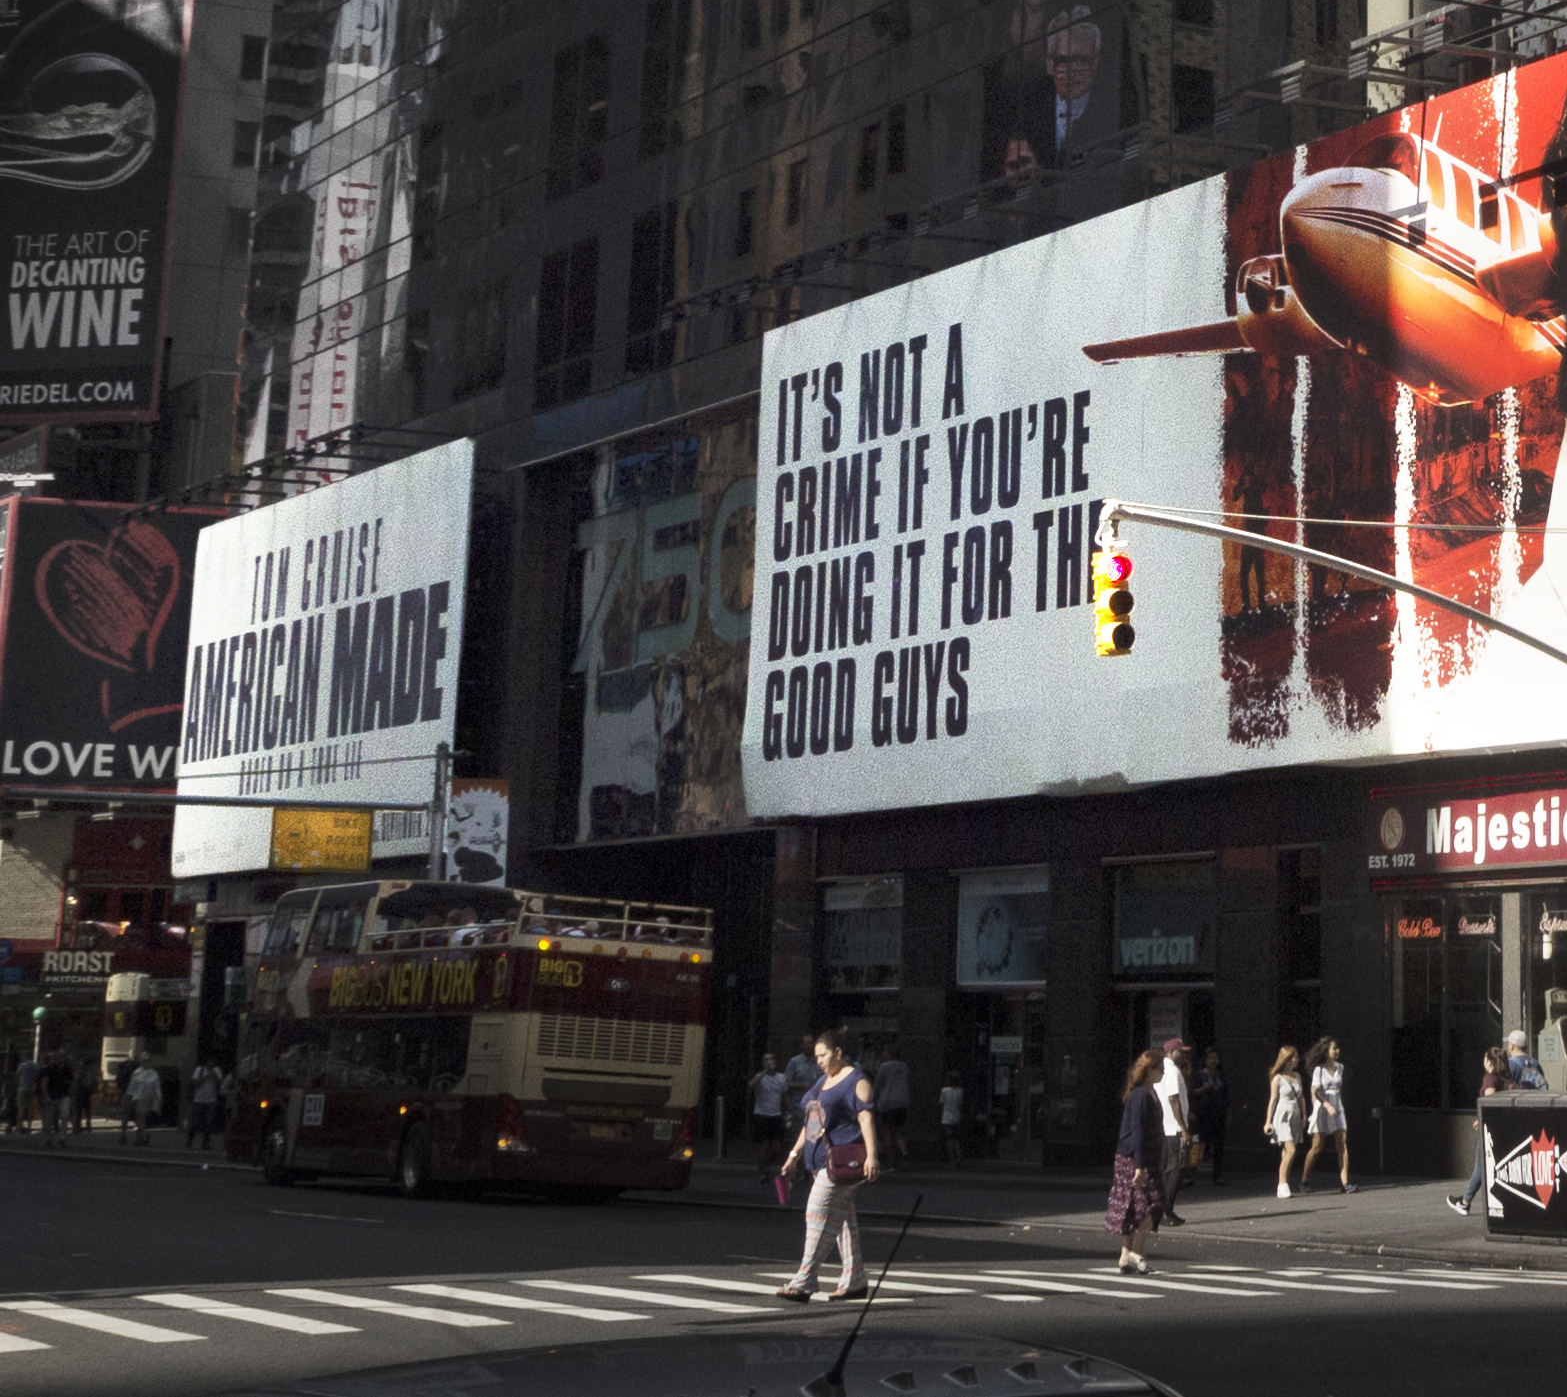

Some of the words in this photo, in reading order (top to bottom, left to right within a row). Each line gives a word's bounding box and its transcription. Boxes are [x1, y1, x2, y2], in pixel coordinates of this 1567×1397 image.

[14, 233, 58, 257] THE
[64, 231, 108, 255] ART
[115, 229, 149, 254] OF
[11, 256, 146, 288] DECANTING
[9, 288, 144, 349] WINE
[776, 361, 843, 467] IT'S
[859, 334, 927, 444] NOT
[942, 323, 965, 420] A
[774, 448, 882, 562] CRIME
[898, 434, 930, 534] IF
[948, 390, 1091, 521] YOU'RE
[250, 545, 291, 625] TOM
[302, 517, 383, 612] CRUISE
[768, 544, 875, 662] DOING
[891, 539, 927, 640] IT
[942, 520, 1013, 630] FOR
[183, 612, 325, 765] AMERICAN
[327, 580, 450, 739] MADE
[762, 657, 857, 762] GOOD
[872, 636, 971, 748] GUYS
[2, 740, 116, 778] LOVE
[1368, 855, 1390, 869] EST.
[1391, 853, 1416, 868] 1972
[44, 951, 115, 972] ROAST
[539, 958, 564, 973] BIG
[1120, 927, 1196, 966] verizon
[387, 960, 428, 1005] NEW
[431, 958, 479, 1004] YORK
[1534, 1150, 1554, 1186] LOVE
